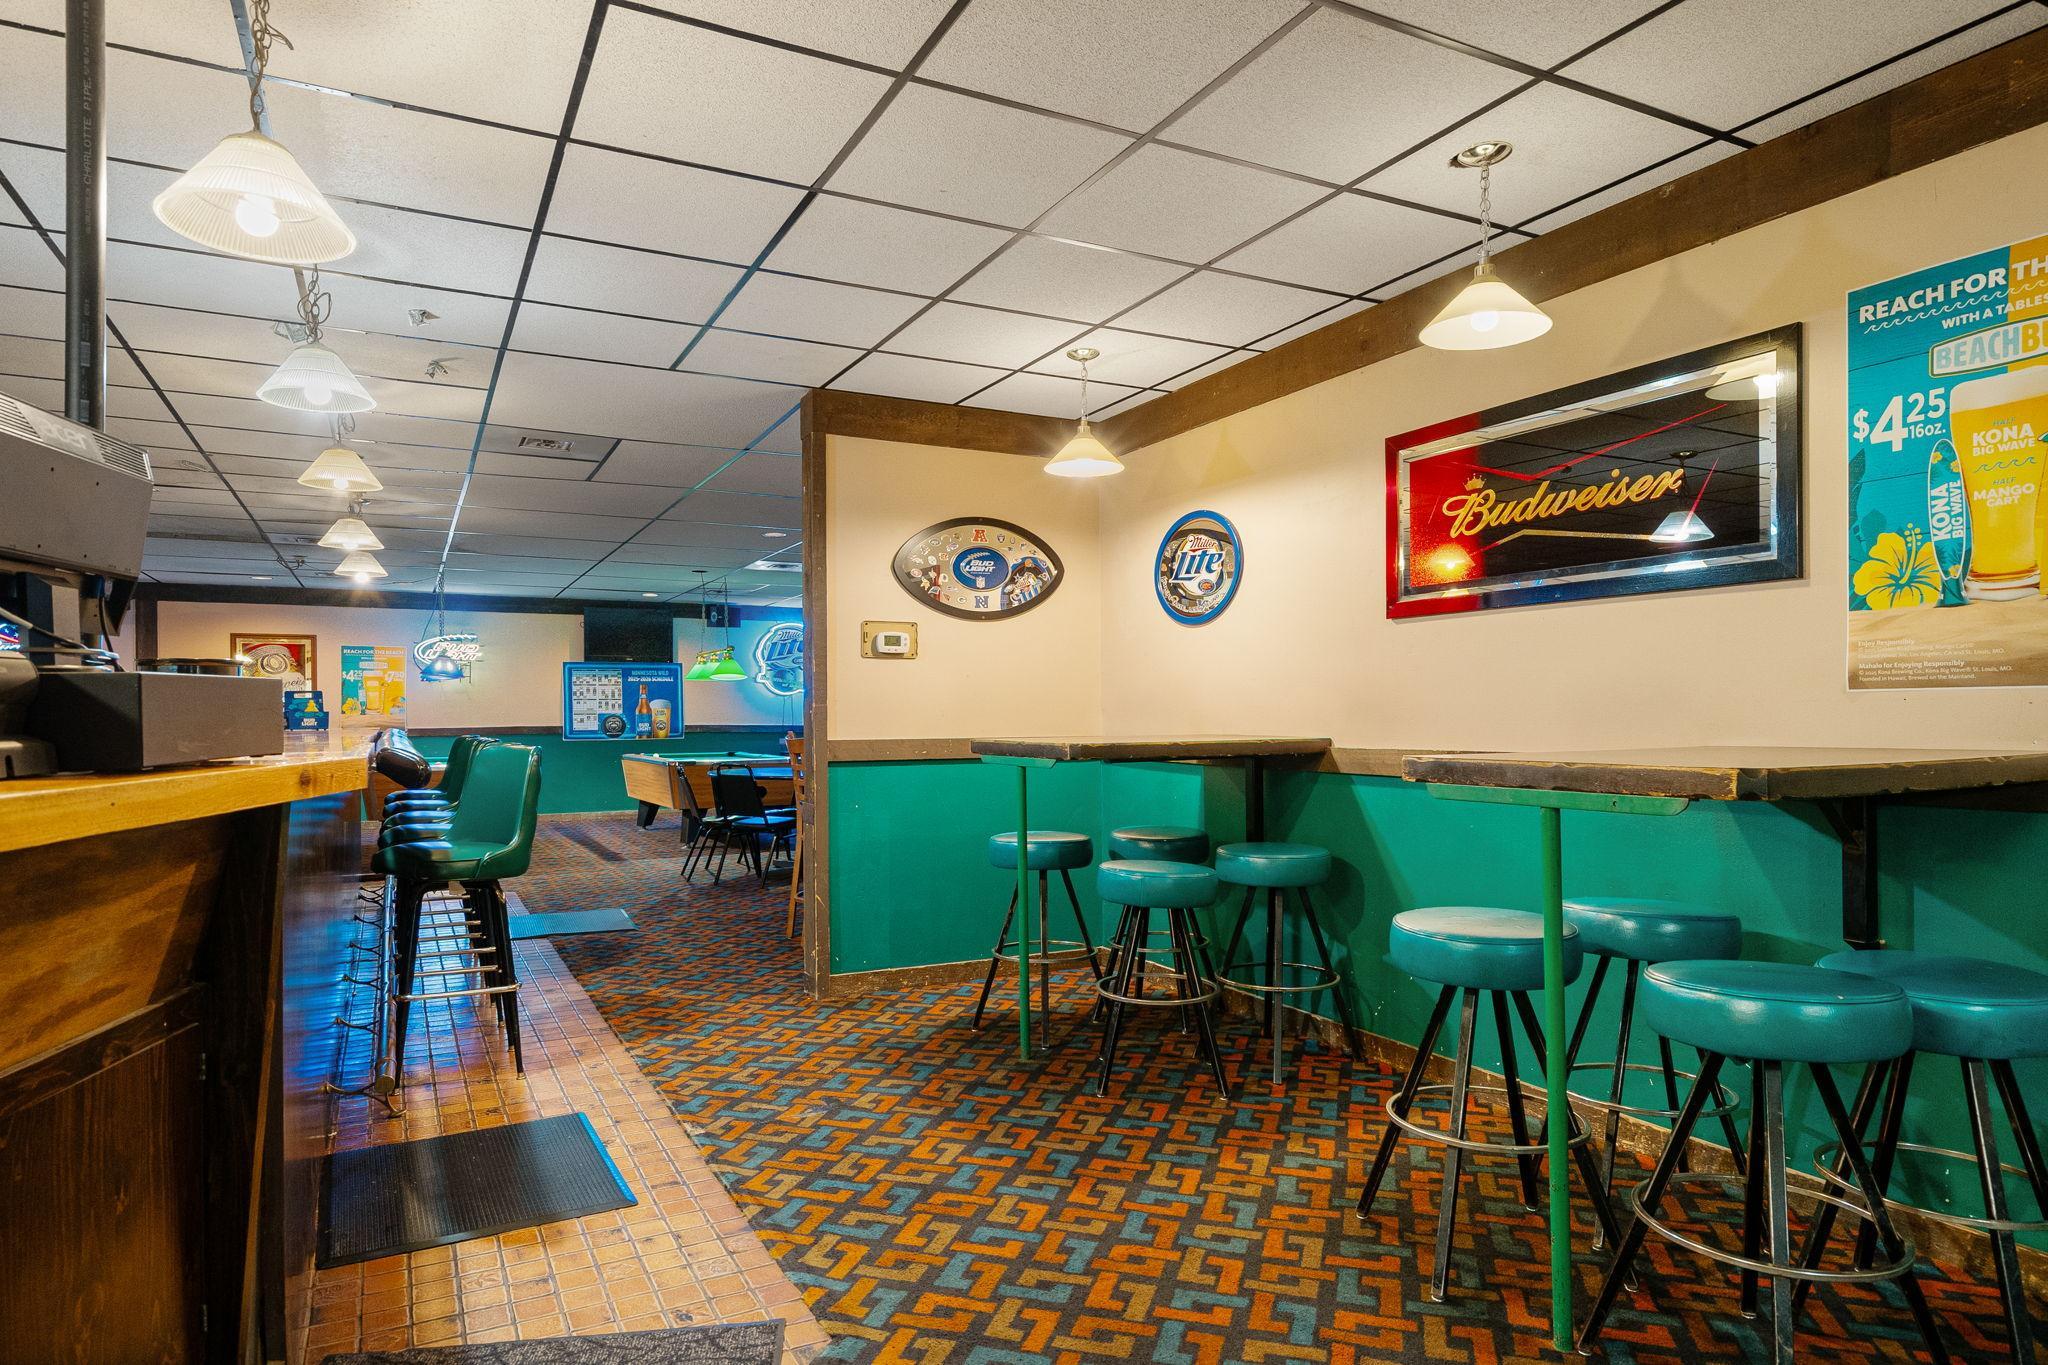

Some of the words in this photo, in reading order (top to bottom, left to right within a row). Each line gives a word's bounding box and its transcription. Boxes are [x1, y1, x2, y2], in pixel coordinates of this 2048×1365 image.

[83, 116, 92, 185] CHARLOTTE
[1859, 283, 1945, 324] REACH
[1950, 267, 2007, 299] FOR
[1941, 309, 1980, 330] WITH
[1982, 307, 1994, 320] A
[39, 418, 88, 450] acer
[1972, 422, 2035, 447] KONA
[1973, 445, 1995, 457] BIG
[1997, 437, 2036, 452] WAVE
[1973, 482, 2036, 502] MANGO
[1993, 476, 2016, 486] HALF
[1443, 467, 1684, 539] Budweiser
[1949, 480, 1963, 516] WAVE
[1986, 495, 2021, 508] CART
[1930, 482, 1952, 542] KONA
[1951, 516, 1964, 539] BIG
[1188, 535, 1217, 549] Miller
[970, 559, 995, 567] BUD
[1171, 550, 1224, 581] Lite
[1924, 659, 1965, 668] Responsibly
